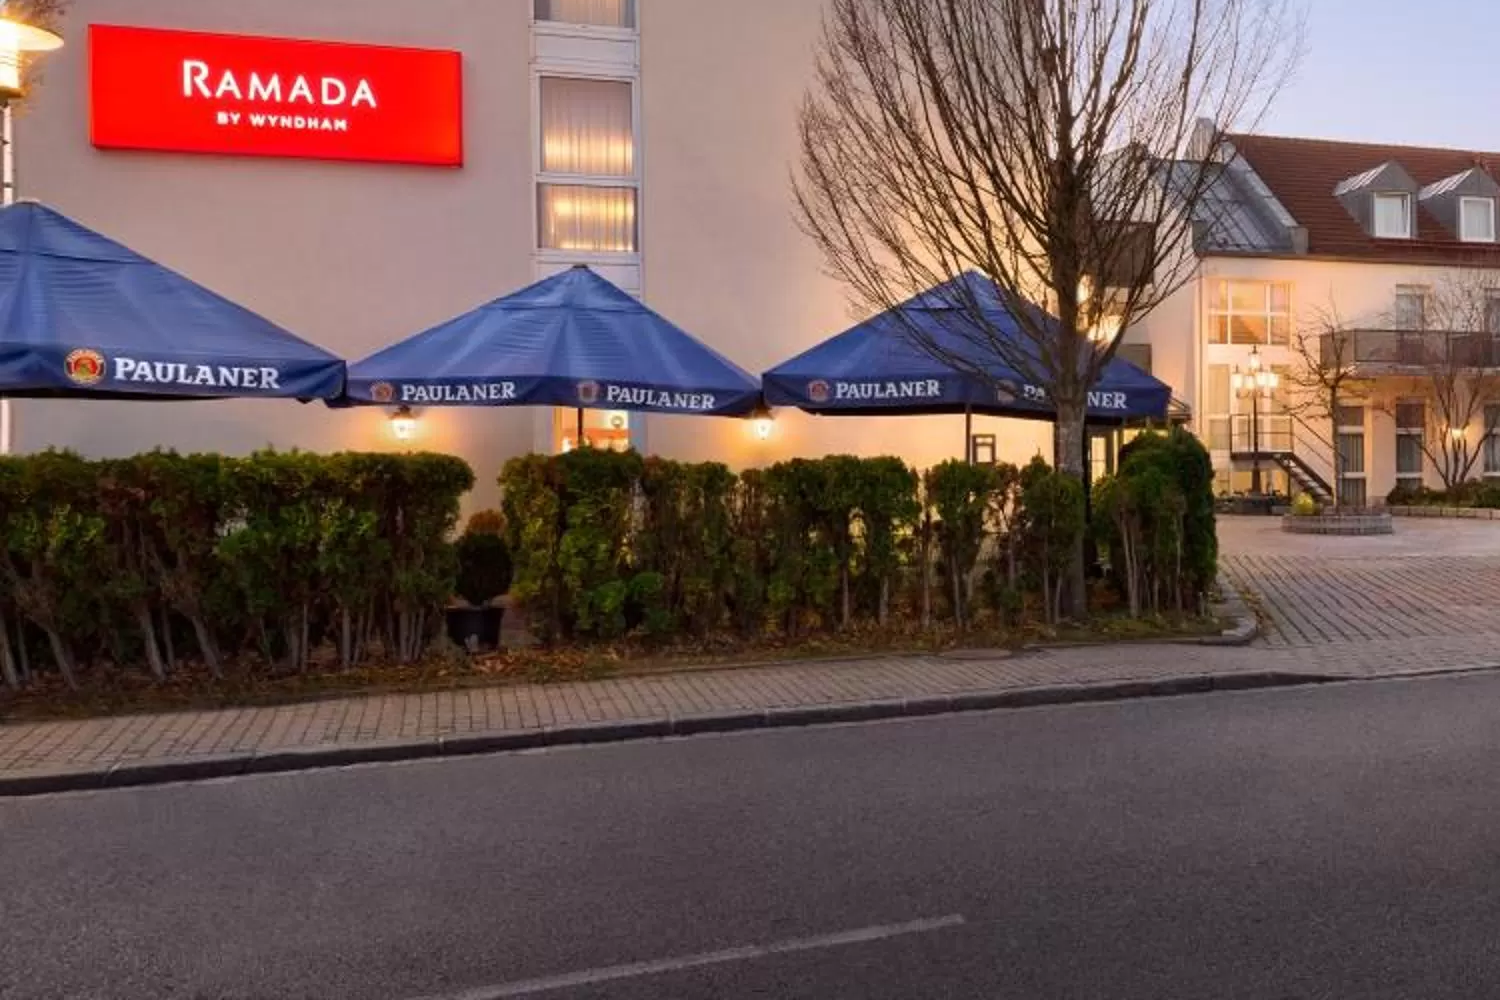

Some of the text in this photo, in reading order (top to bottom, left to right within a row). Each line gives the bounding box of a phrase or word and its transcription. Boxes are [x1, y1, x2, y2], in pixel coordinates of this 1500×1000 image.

[182, 59, 377, 108] RAMADA
[216, 111, 348, 131] BY WYNDHAM
[113, 357, 280, 389] PAULANER
[402, 381, 516, 401] PAULANER
[607, 385, 716, 409] PAULANER
[835, 379, 940, 399] PAULANER
[1023, 383, 1127, 409] PANER
